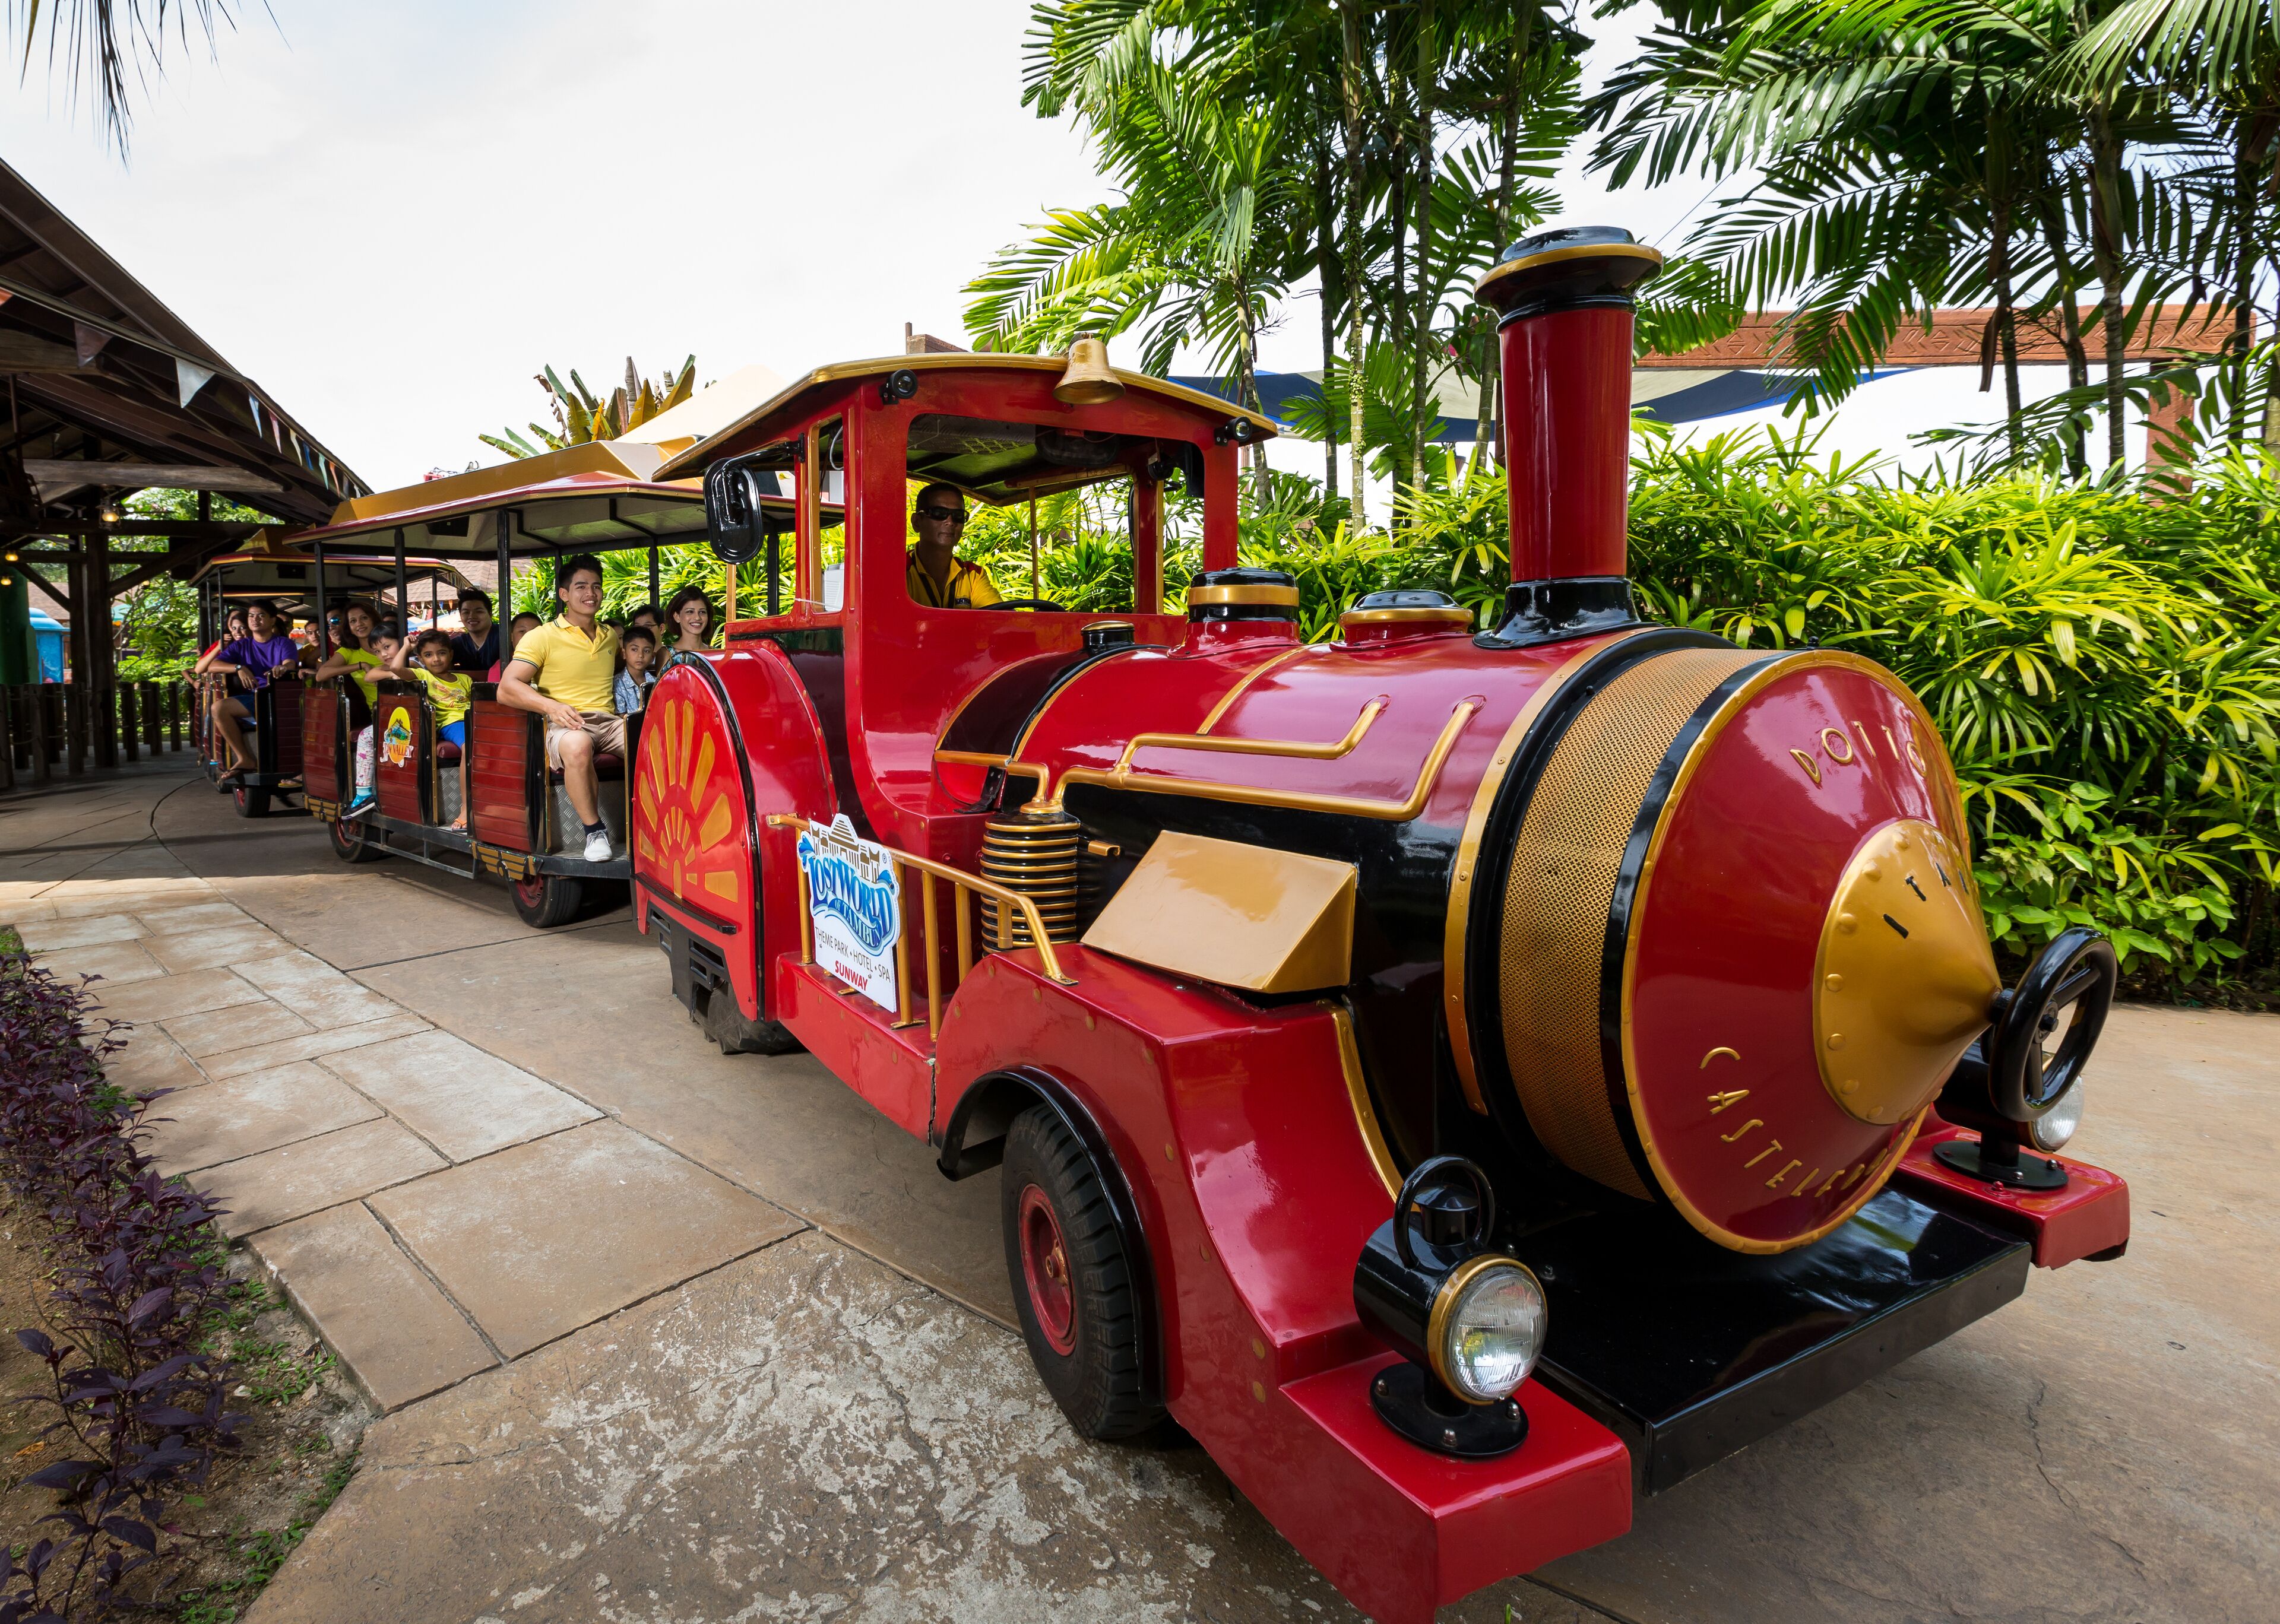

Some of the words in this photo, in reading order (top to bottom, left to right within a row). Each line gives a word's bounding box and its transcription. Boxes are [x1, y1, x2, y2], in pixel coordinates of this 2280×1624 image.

[808, 857, 838, 909] LOST
[837, 858, 891, 938] WORLD
[834, 900, 842, 911] OF
[842, 903, 882, 947] TAMBUN
[1883, 862, 1970, 939] ITAL
[815, 926, 834, 949] THEME
[834, 938, 849, 958] PARK
[853, 950, 873, 972] HOTEL
[878, 964, 891, 983] SPA
[835, 960, 869, 991] SUNWAY
